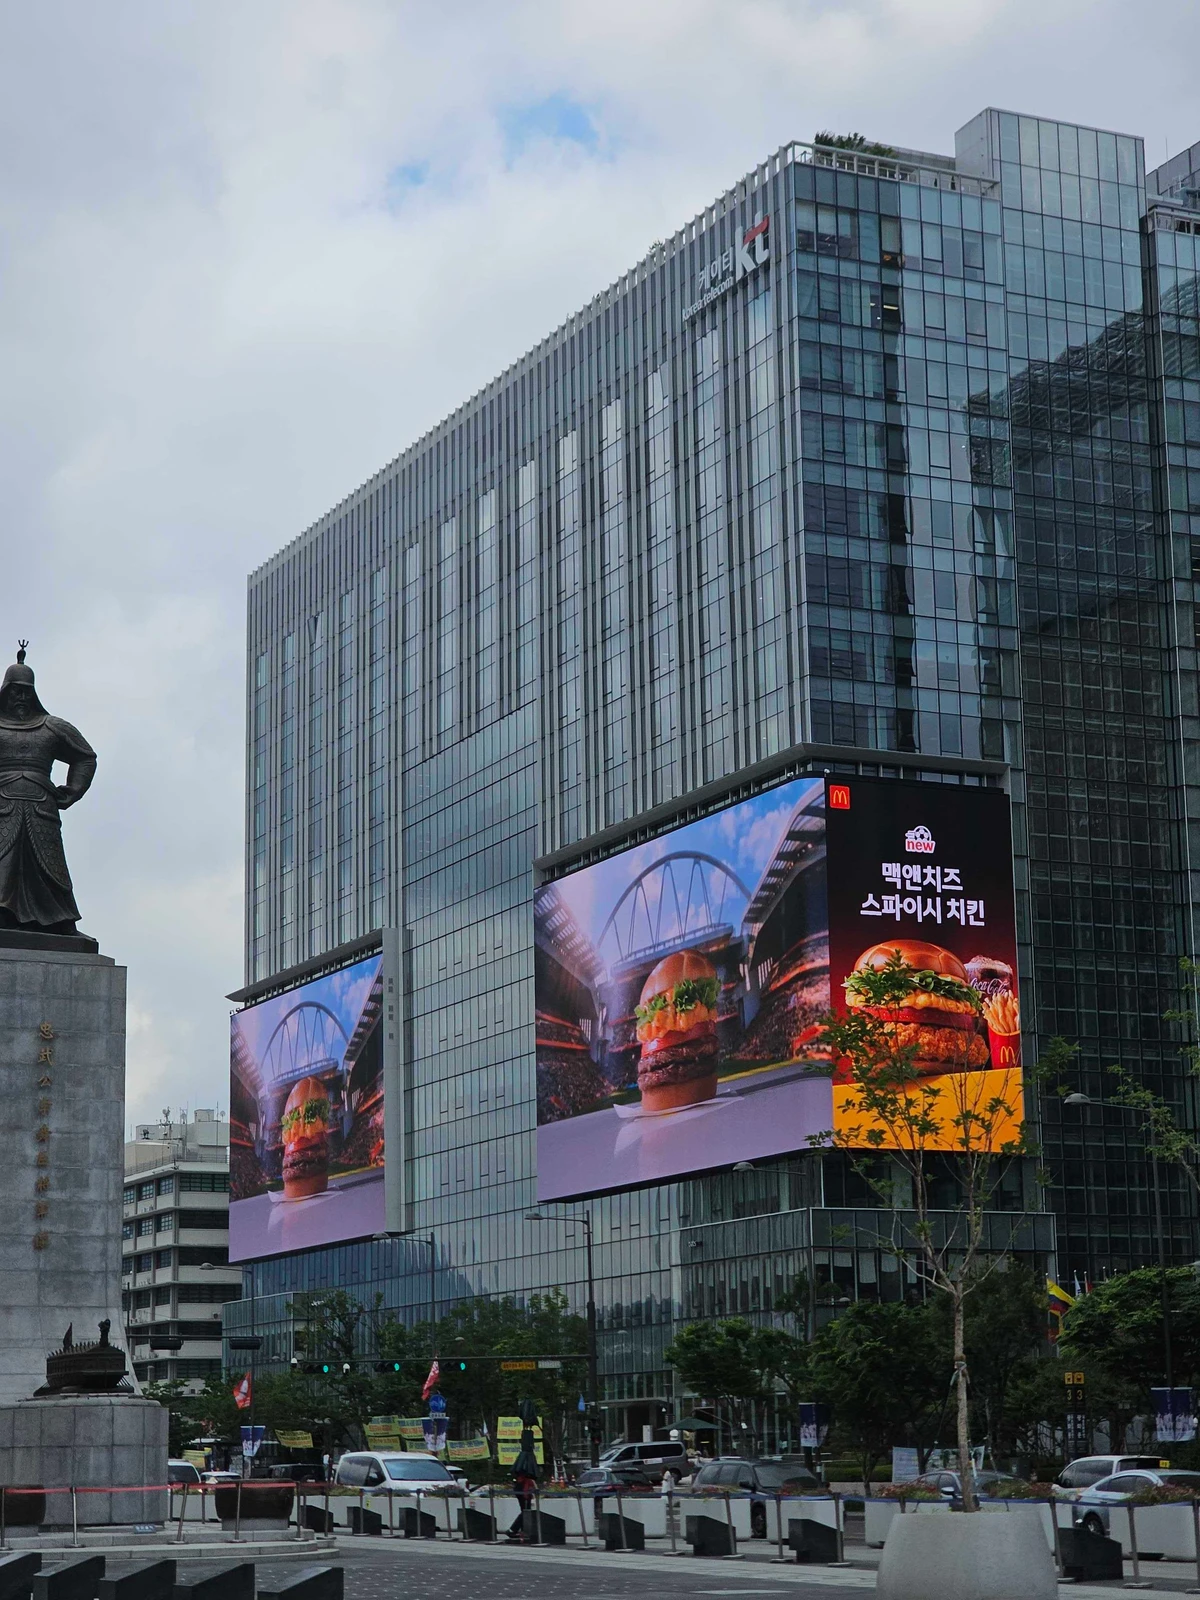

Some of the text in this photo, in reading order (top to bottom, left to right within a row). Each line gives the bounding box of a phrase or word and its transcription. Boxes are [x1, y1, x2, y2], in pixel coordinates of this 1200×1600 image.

[699, 247, 734, 290] 케이티
[682, 276, 734, 322] korea telecom
[907, 840, 934, 852] new
[881, 862, 964, 893] 맥앤치즈
[860, 893, 985, 926] 스파이시 치킨
